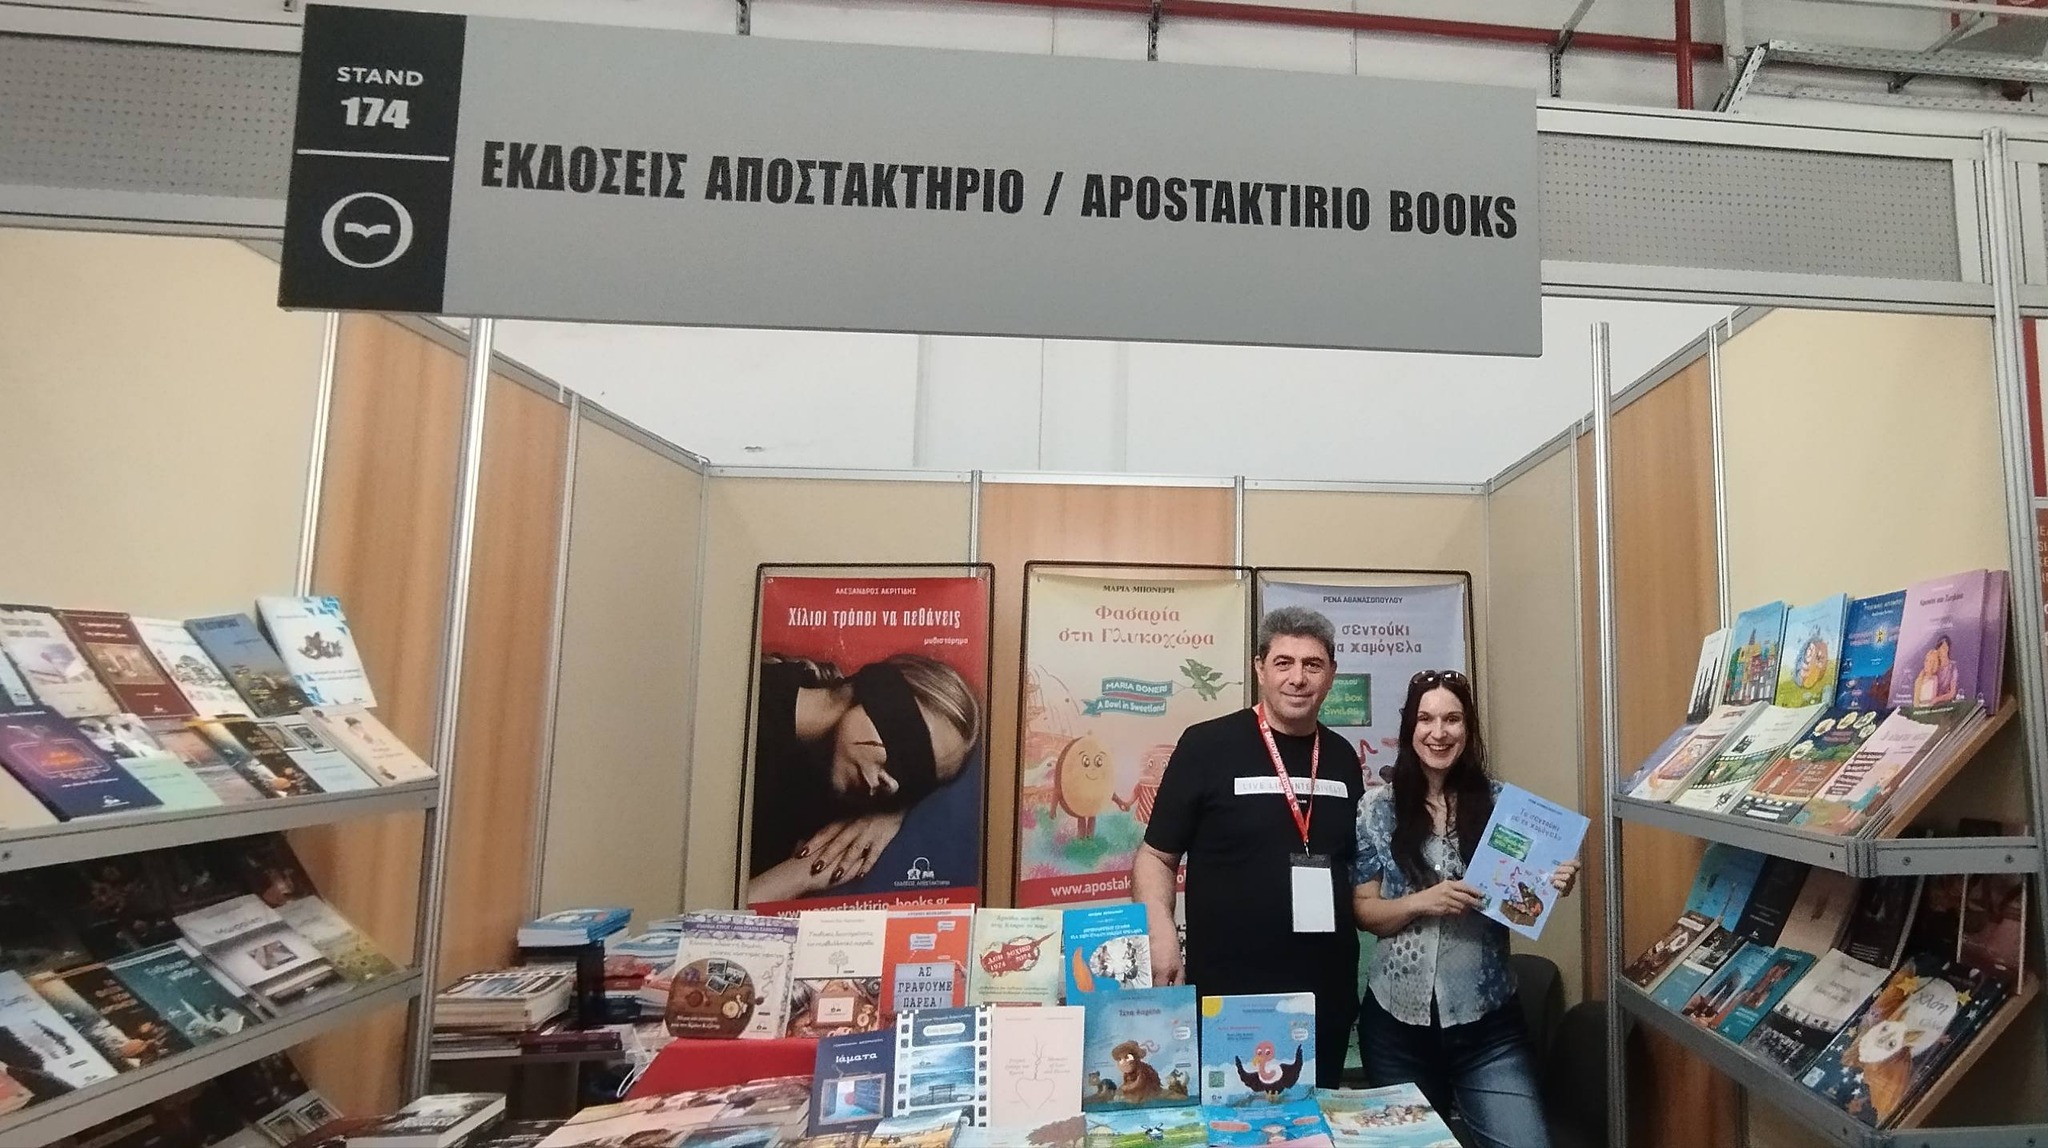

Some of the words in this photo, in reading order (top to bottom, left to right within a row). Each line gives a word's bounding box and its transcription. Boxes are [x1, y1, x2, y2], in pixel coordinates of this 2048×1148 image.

[337, 66, 424, 87] STAND
[341, 96, 410, 130] 174
[481, 140, 688, 199] ΕΚΔΟΣΕΙΣ
[704, 155, 1025, 215] ΑΠΟΣΤΑΚΤΗΡΙΟ
[1043, 171, 1064, 216] /
[1080, 173, 1371, 232] APOSTAKTIRIO
[1389, 190, 1518, 240] BOOKS
[835, 587, 879, 596] ΑΛΕΞΑΝΔΡΟΣ
[881, 587, 917, 595] ΑΚΡΙΤΙΔΗΣ
[1103, 584, 1131, 593] ΜΑΡΙΑ
[1133, 585, 1175, 594] ΜΠΟΝΕΡΗ
[1323, 596, 1342, 604] ΡΕΝΑ
[1343, 596, 1403, 604] ΑΘΑΝΑΣΟΠΟΥΛΟΥ
[788, 607, 828, 627] Χίλιοι
[832, 607, 877, 629] τρόποι
[882, 611, 897, 627] να
[903, 606, 961, 629] πεθάνεις
[1095, 604, 1181, 626] Φασαρία
[1342, 621, 1410, 637] σεντούκι
[1058, 627, 1094, 643] στη
[1101, 627, 1215, 650] Γλυκοχώρα
[1351, 639, 1422, 656] χαμόγελα
[1105, 681, 1135, 692] MARIA
[1122, 701, 1129, 710] in
[918, 966, 932, 977] ΑΣ
[898, 981, 953, 993] ΓΡΑΨΟΥΜΕ
[835, 1052, 878, 1064] Ιάματα
